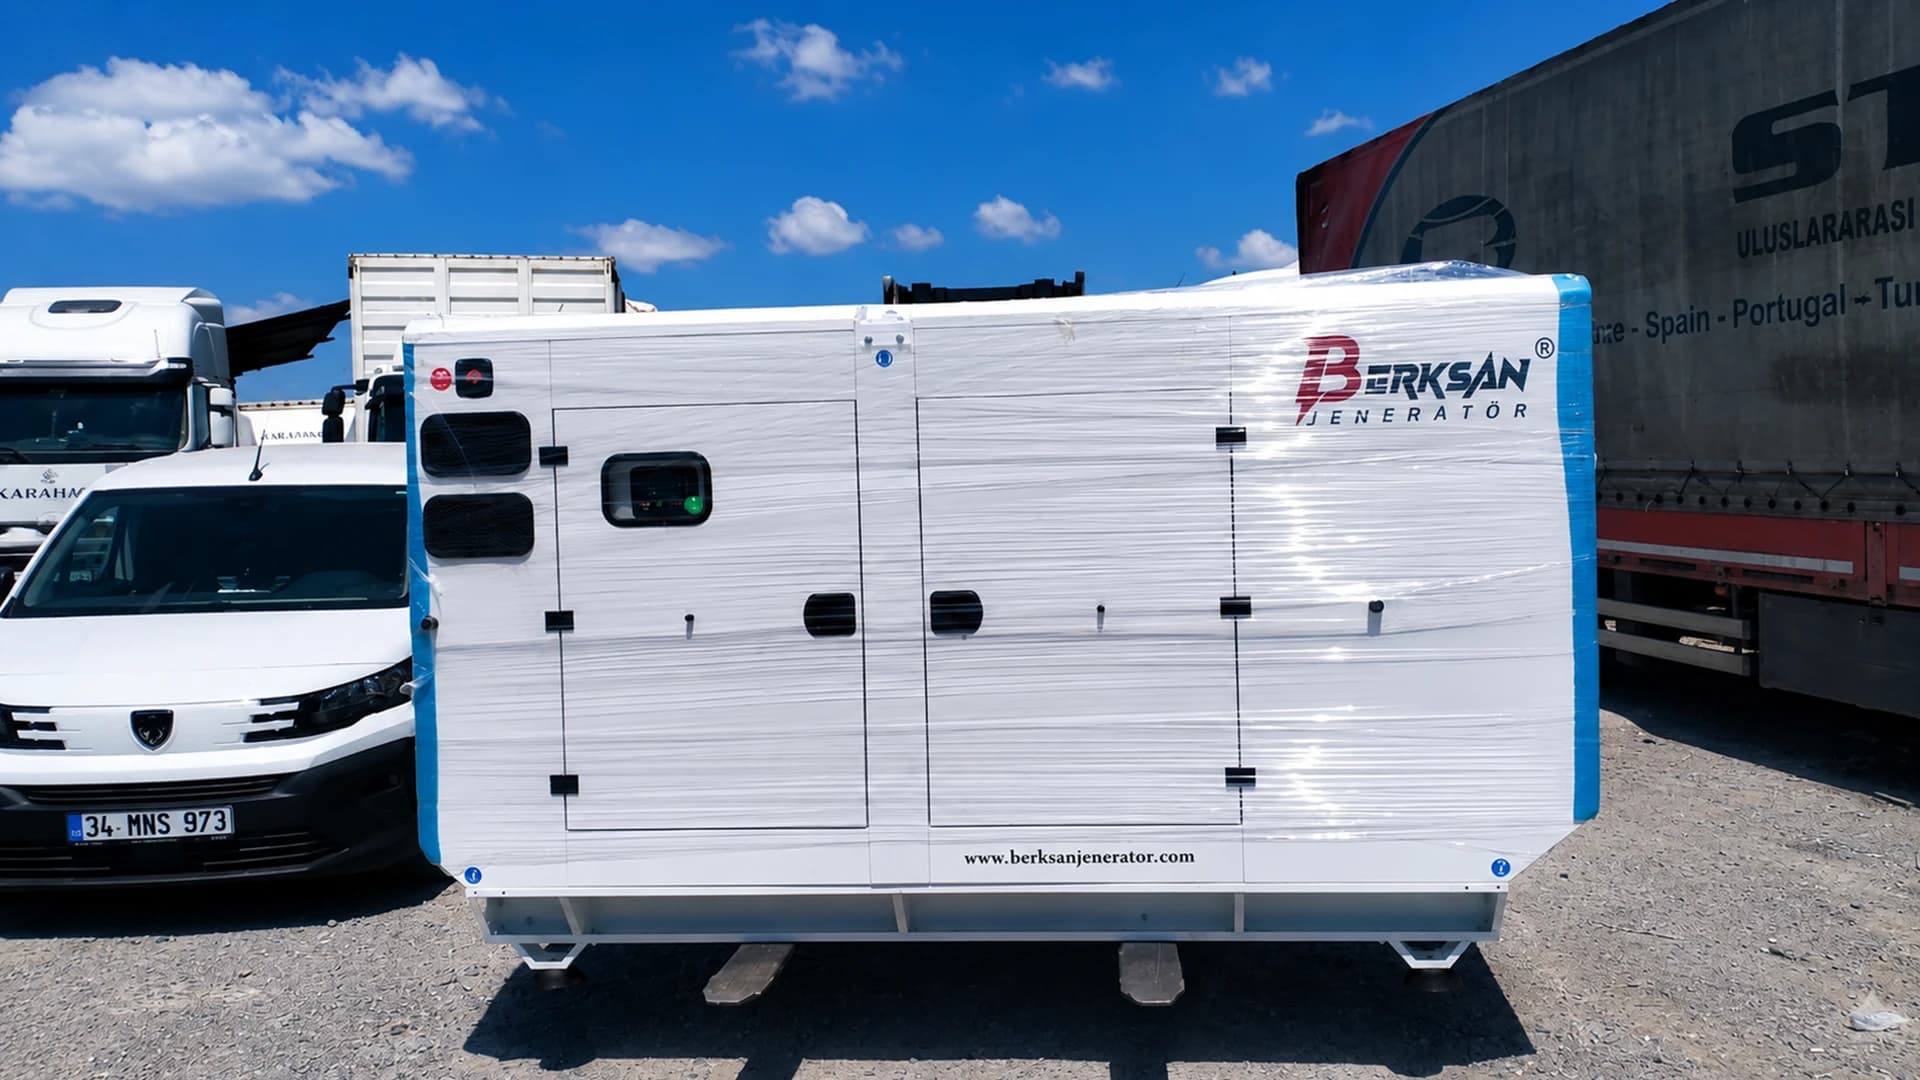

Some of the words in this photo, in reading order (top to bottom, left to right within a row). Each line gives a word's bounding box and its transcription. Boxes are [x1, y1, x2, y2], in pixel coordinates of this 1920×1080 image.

[1737, 197, 1915, 258] ULUSLARARASI
[1645, 305, 1710, 345] Spain
[1733, 283, 1846, 327] Portugal
[1296, 335, 1531, 424] BERKSAN
[1306, 401, 1528, 426] JENERATÖR
[85, 815, 114, 838] 34
[127, 812, 171, 837] MNS
[183, 810, 227, 834] 973
[964, 849, 1195, 868] www.berksanjenerator.com
